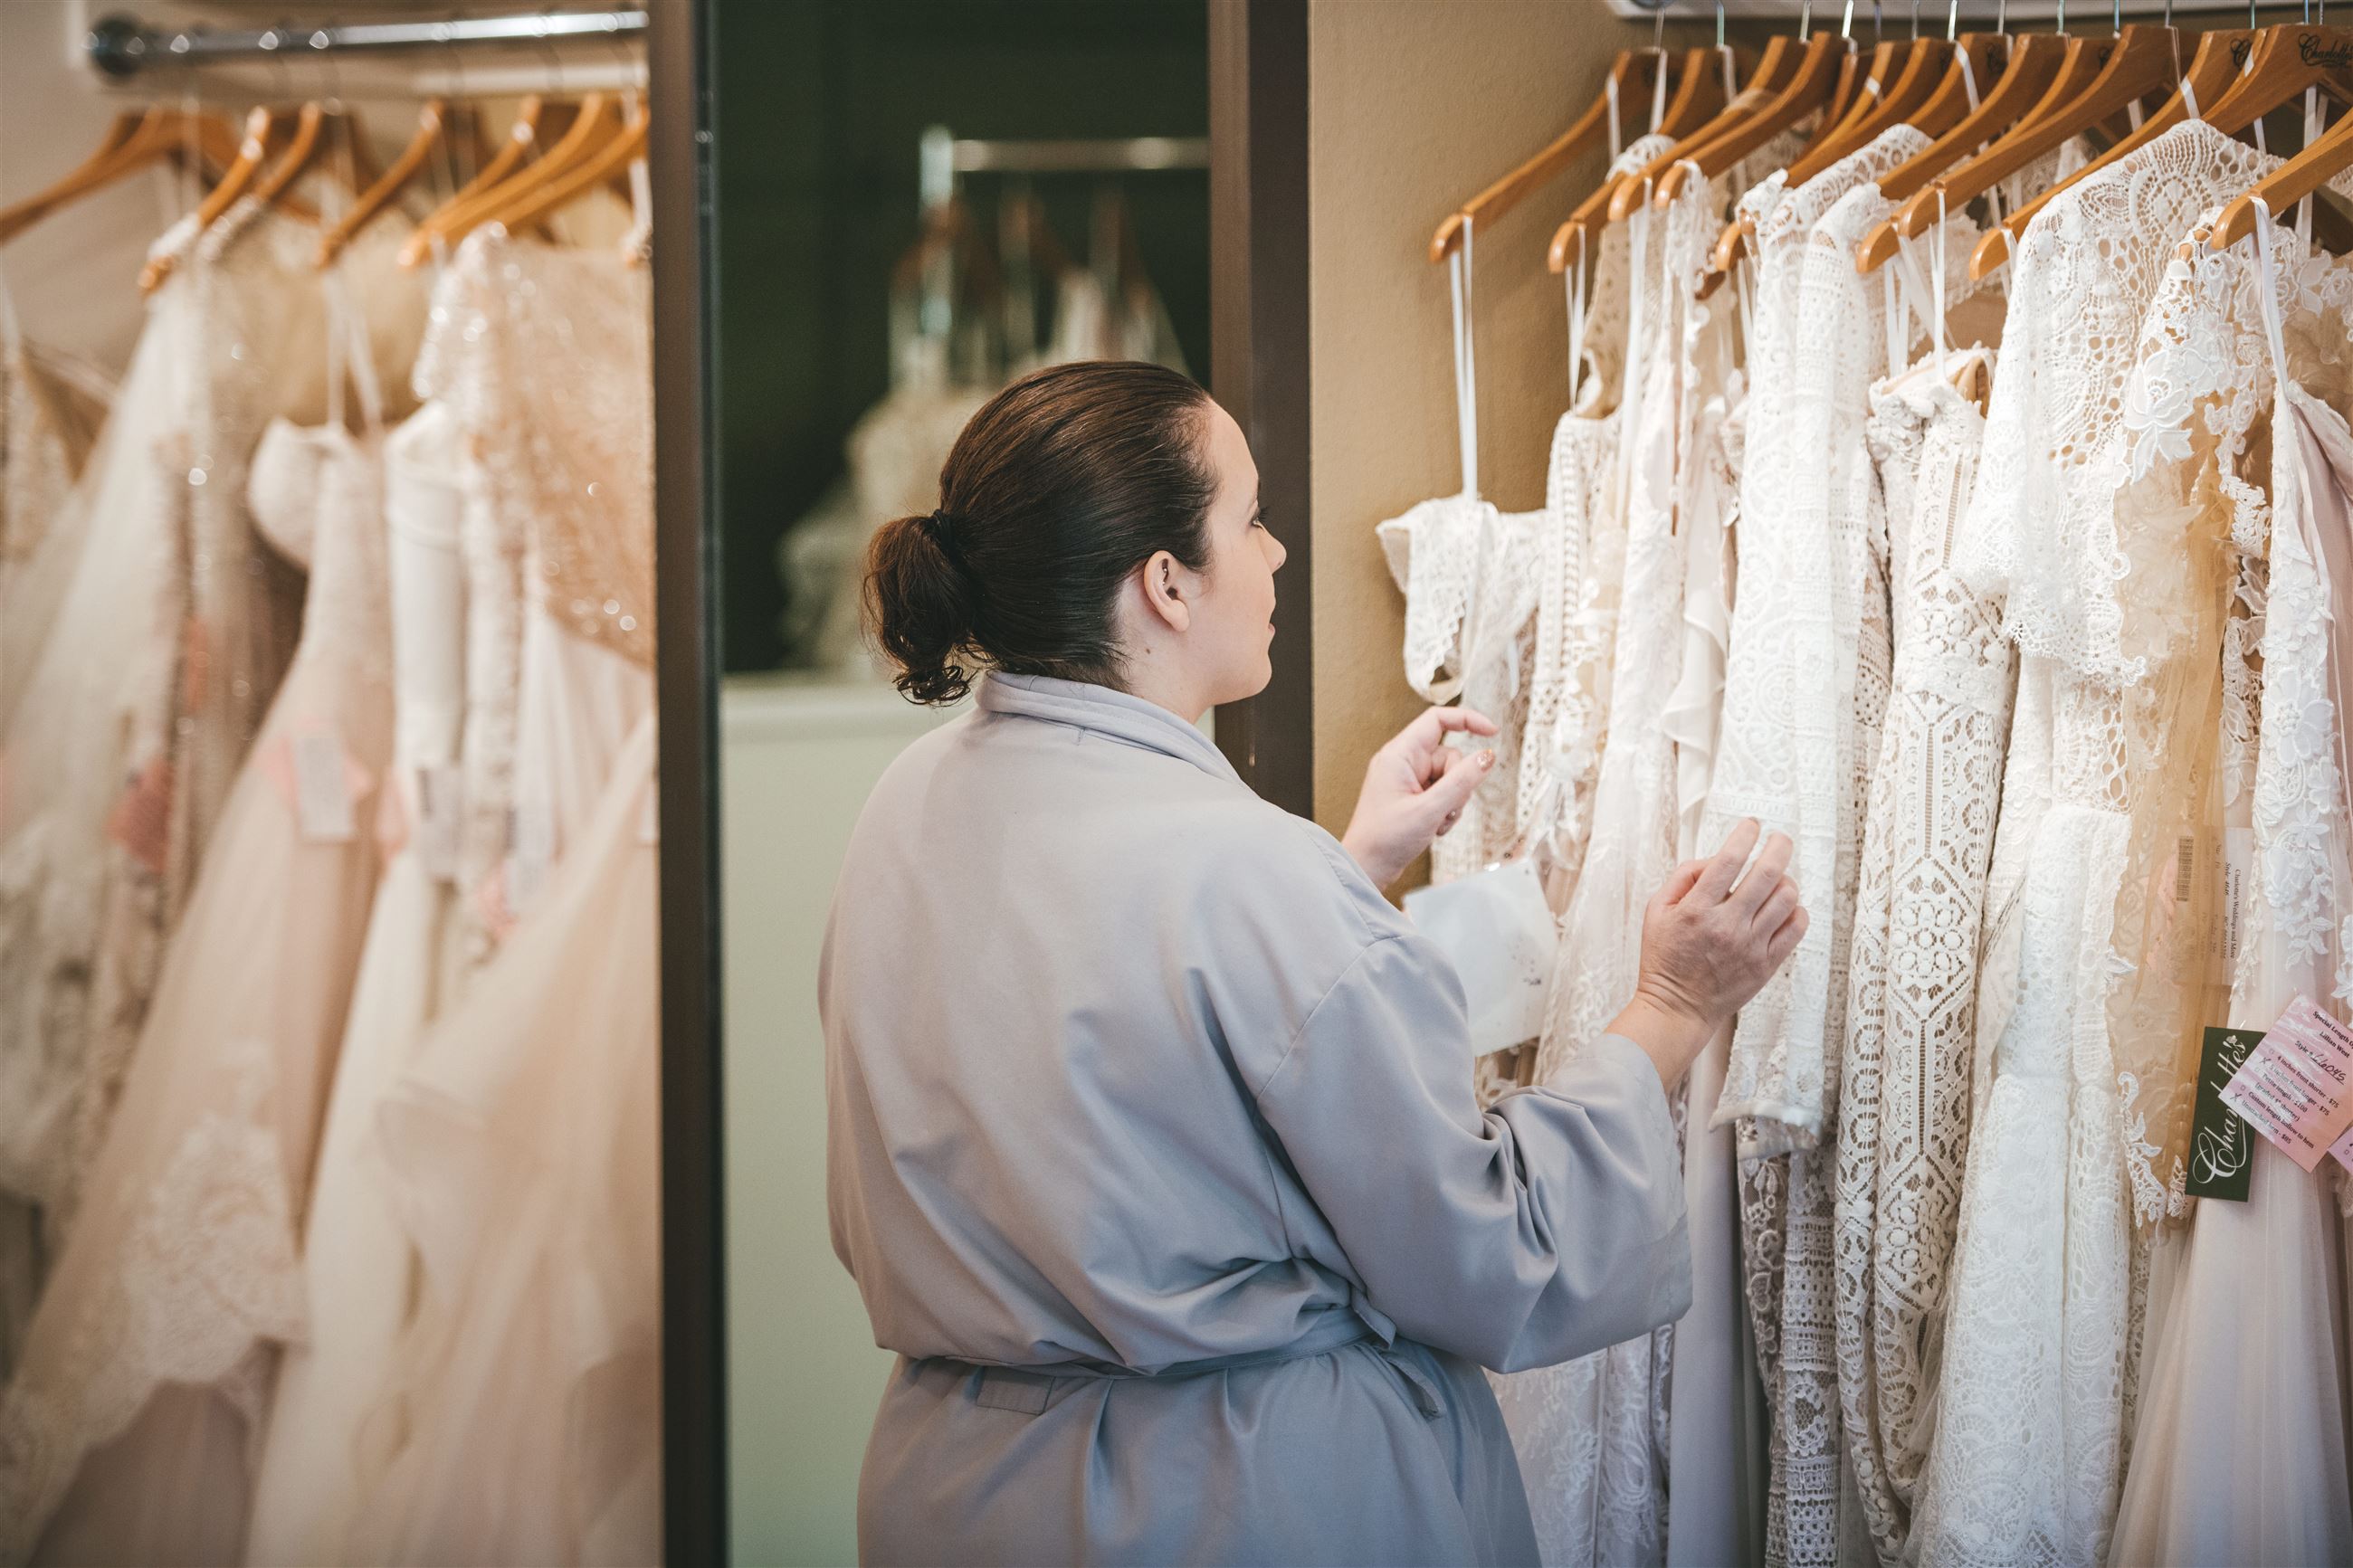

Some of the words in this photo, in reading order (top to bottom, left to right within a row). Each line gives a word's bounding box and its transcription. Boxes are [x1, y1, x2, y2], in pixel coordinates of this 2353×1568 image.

[2234, 870, 2242, 899] Charlotte's
[2231, 901, 2239, 929] Weddings
[2311, 1011, 2333, 1030] Special
[2330, 1026, 2350, 1044] Length
[2294, 1040, 2309, 1054] Style
[2319, 1031, 2338, 1048] Lillian
[2336, 1045, 2351, 1059] West
[2275, 1085, 2293, 1101] length
[2280, 1059, 2298, 1074] inches
[2295, 1071, 2310, 1085] front
[2307, 1081, 2328, 1099] shorter
[2328, 1098, 2339, 1109] $75
[2193, 1040, 2246, 1184] Chartte's
[2279, 1103, 2301, 1123] shorter)
[2300, 1090, 2318, 1107] longer
[2319, 1106, 2330, 1117] $75
[2247, 1091, 2268, 1109] Custom
[2265, 1106, 2282, 1122] length
[2297, 1132, 2304, 1140] to
[2302, 1136, 2316, 1149] hem
